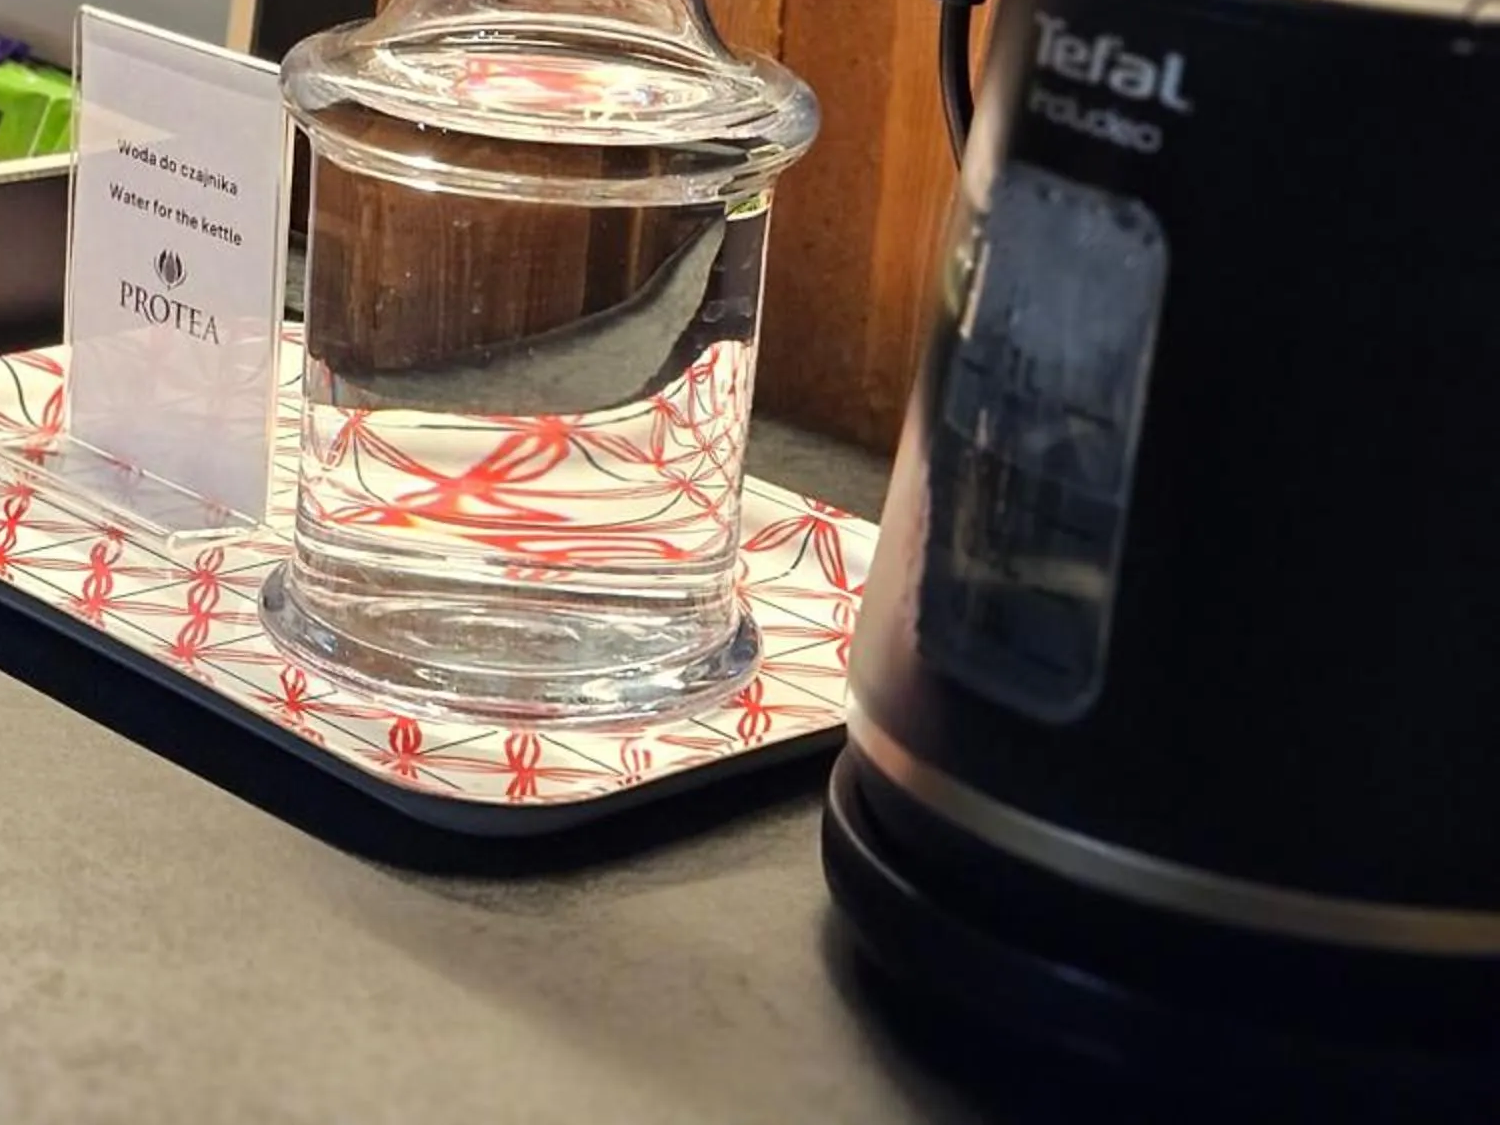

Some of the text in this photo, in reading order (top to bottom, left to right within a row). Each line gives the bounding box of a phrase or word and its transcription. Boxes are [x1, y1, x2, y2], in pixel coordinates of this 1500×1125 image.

[1034, 10, 1194, 114] Tefal
[117, 139, 239, 197] Woda do czajnika
[109, 181, 243, 247] Water for the kettle
[119, 280, 220, 345] PROTEA
